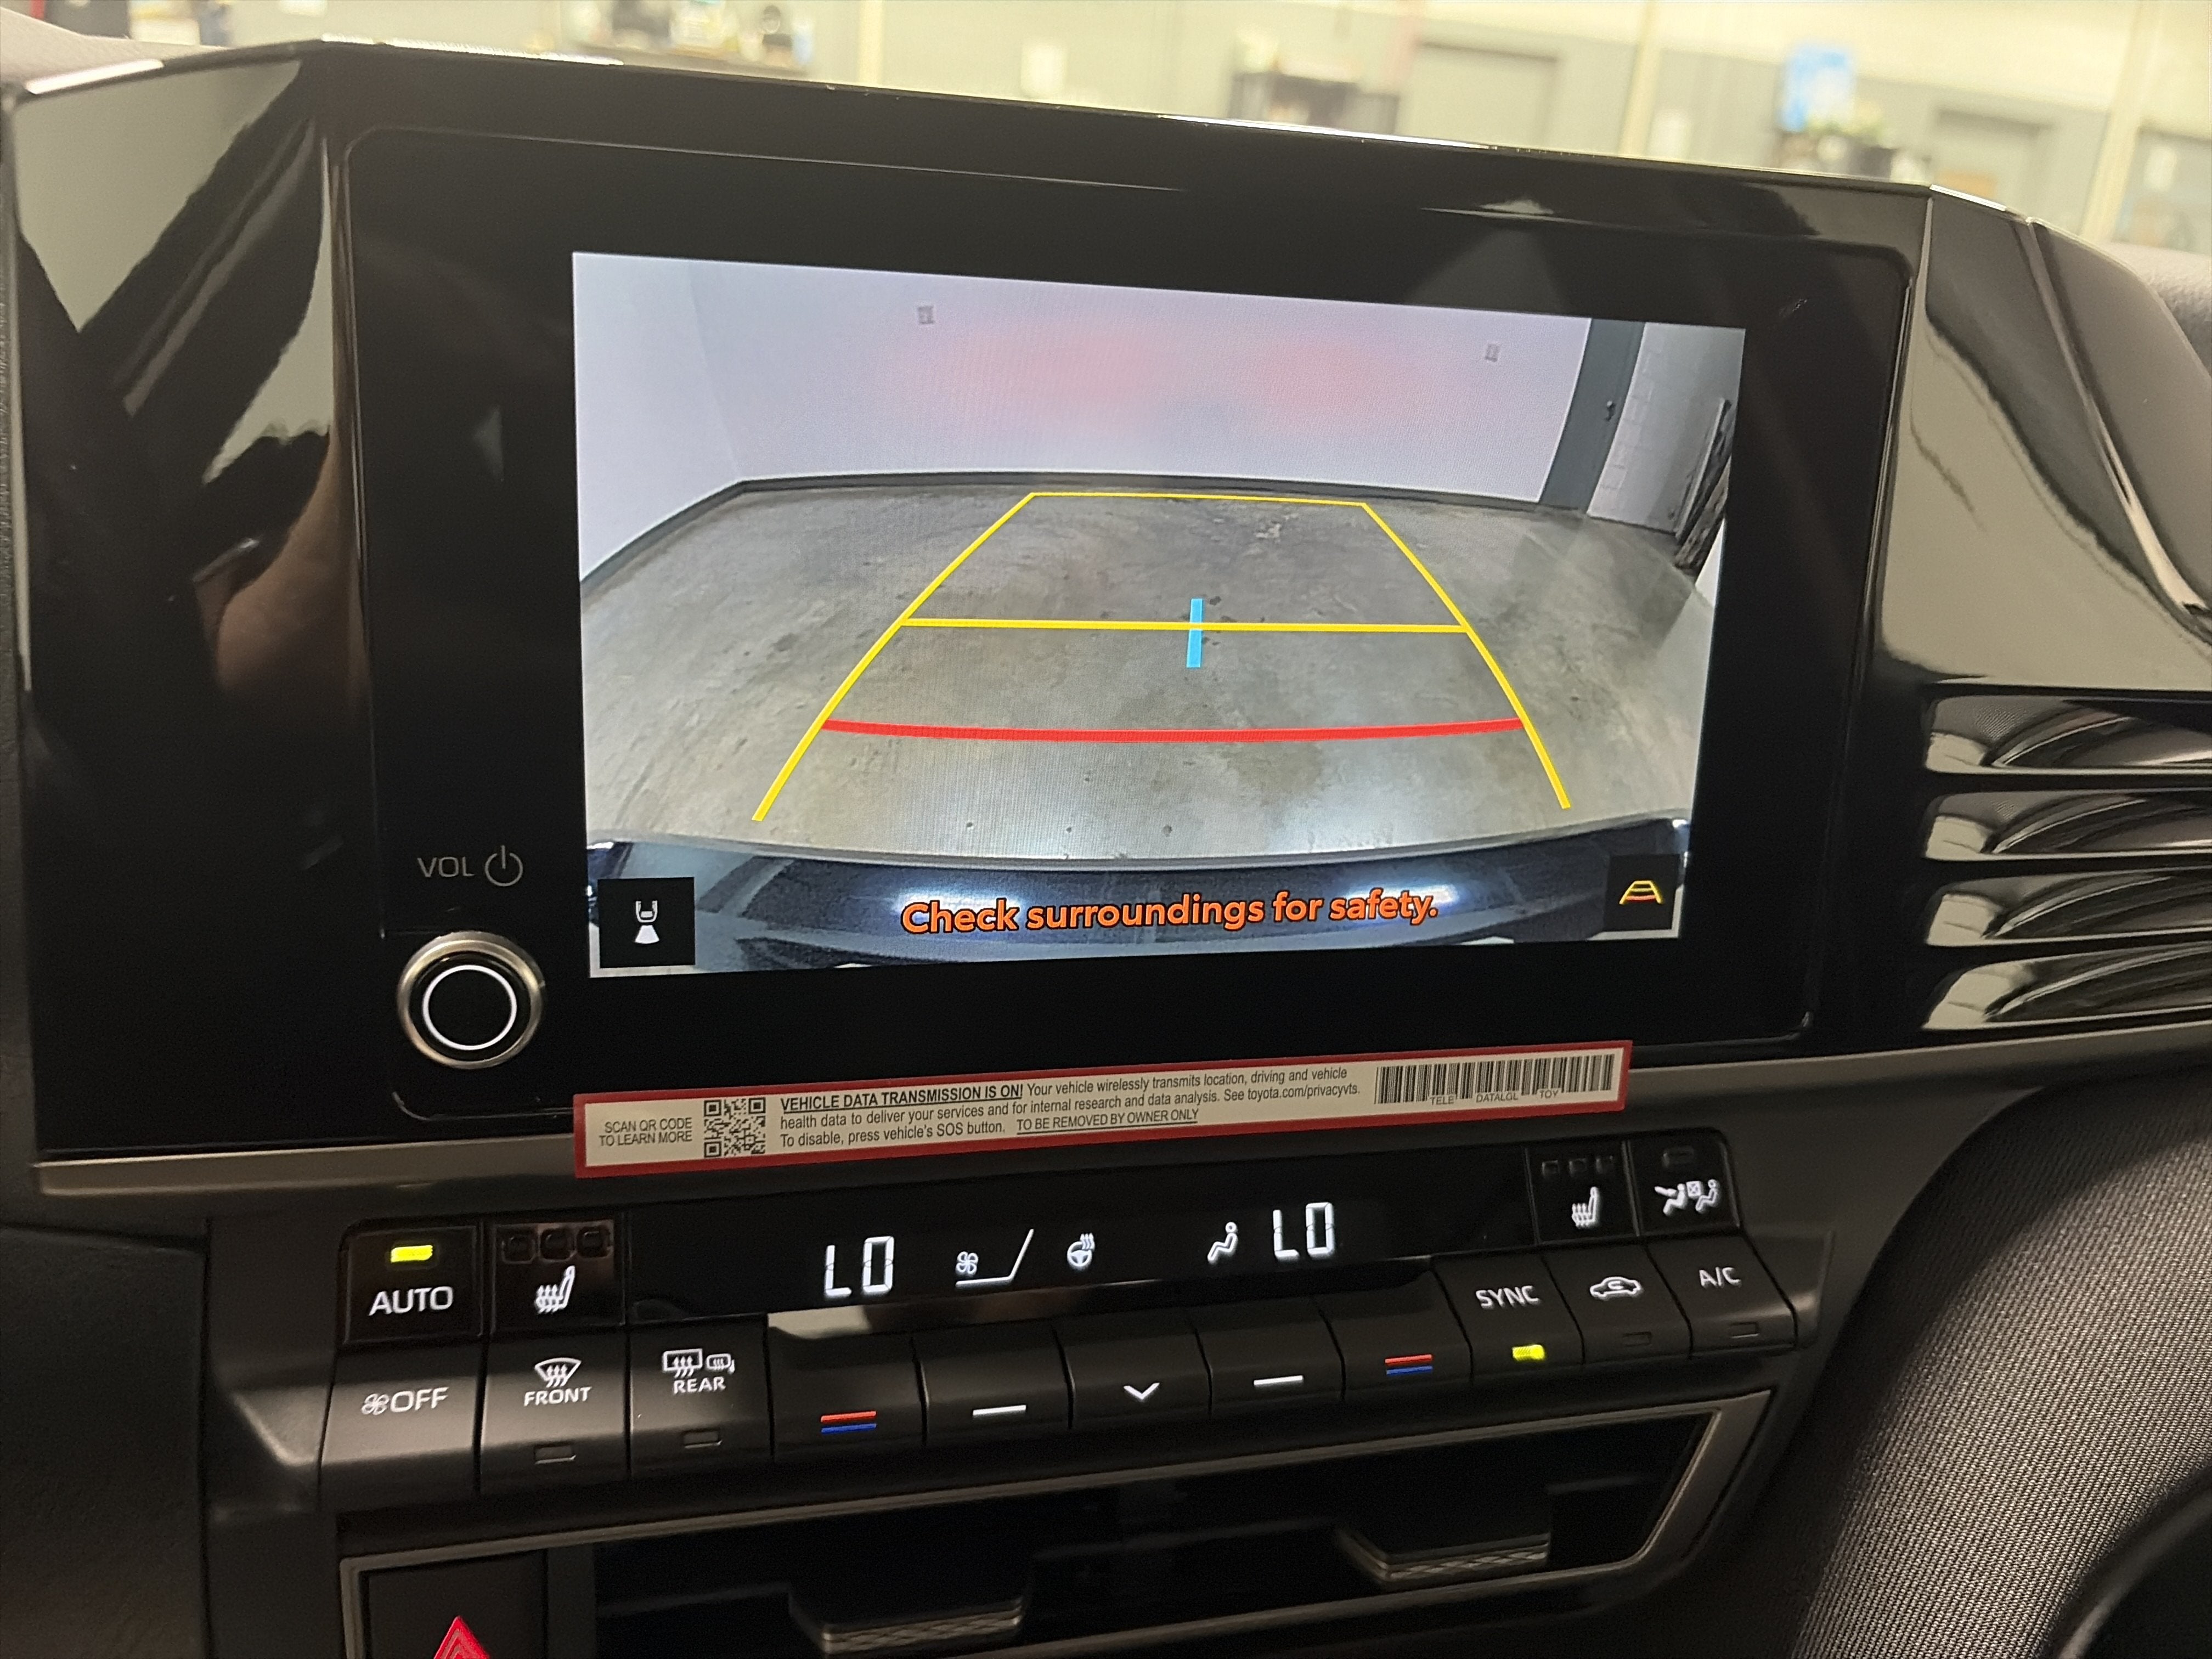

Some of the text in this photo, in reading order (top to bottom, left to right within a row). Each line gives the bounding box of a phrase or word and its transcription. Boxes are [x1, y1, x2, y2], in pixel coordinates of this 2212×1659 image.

[417, 856, 474, 878] VOL
[900, 887, 1439, 934] Check surroundings for safety.
[780, 1066, 1347, 1111] VEHICLE DATA TRANSMISSION IS ON! Your vehicle wirelessly transmits location, driving and vehicle
[1430, 1096, 1454, 1105] TELE
[1539, 1089, 1559, 1099] TOY
[781, 1083, 1361, 1129] health data to deliver your services and for internal research and data analysis. See toyota.com/privacyvts.
[605, 1117, 692, 1133] SCAN QR CODE
[780, 1108, 1199, 1147] To disable, press vehicle's SOS button. TO BE REMOVED BY OWNER ONLY
[599, 1131, 692, 1146] TO LEARN MORE
[1272, 1201, 1335, 1261] LO
[823, 1235, 895, 1299] LO
[1699, 1266, 1741, 1288] A/C
[368, 1286, 454, 1316] AUTO
[1475, 1285, 1541, 1308] SYNC
[524, 1387, 591, 1407] FRONT
[673, 1376, 726, 1394] REAR
[390, 1387, 448, 1414] OFF
